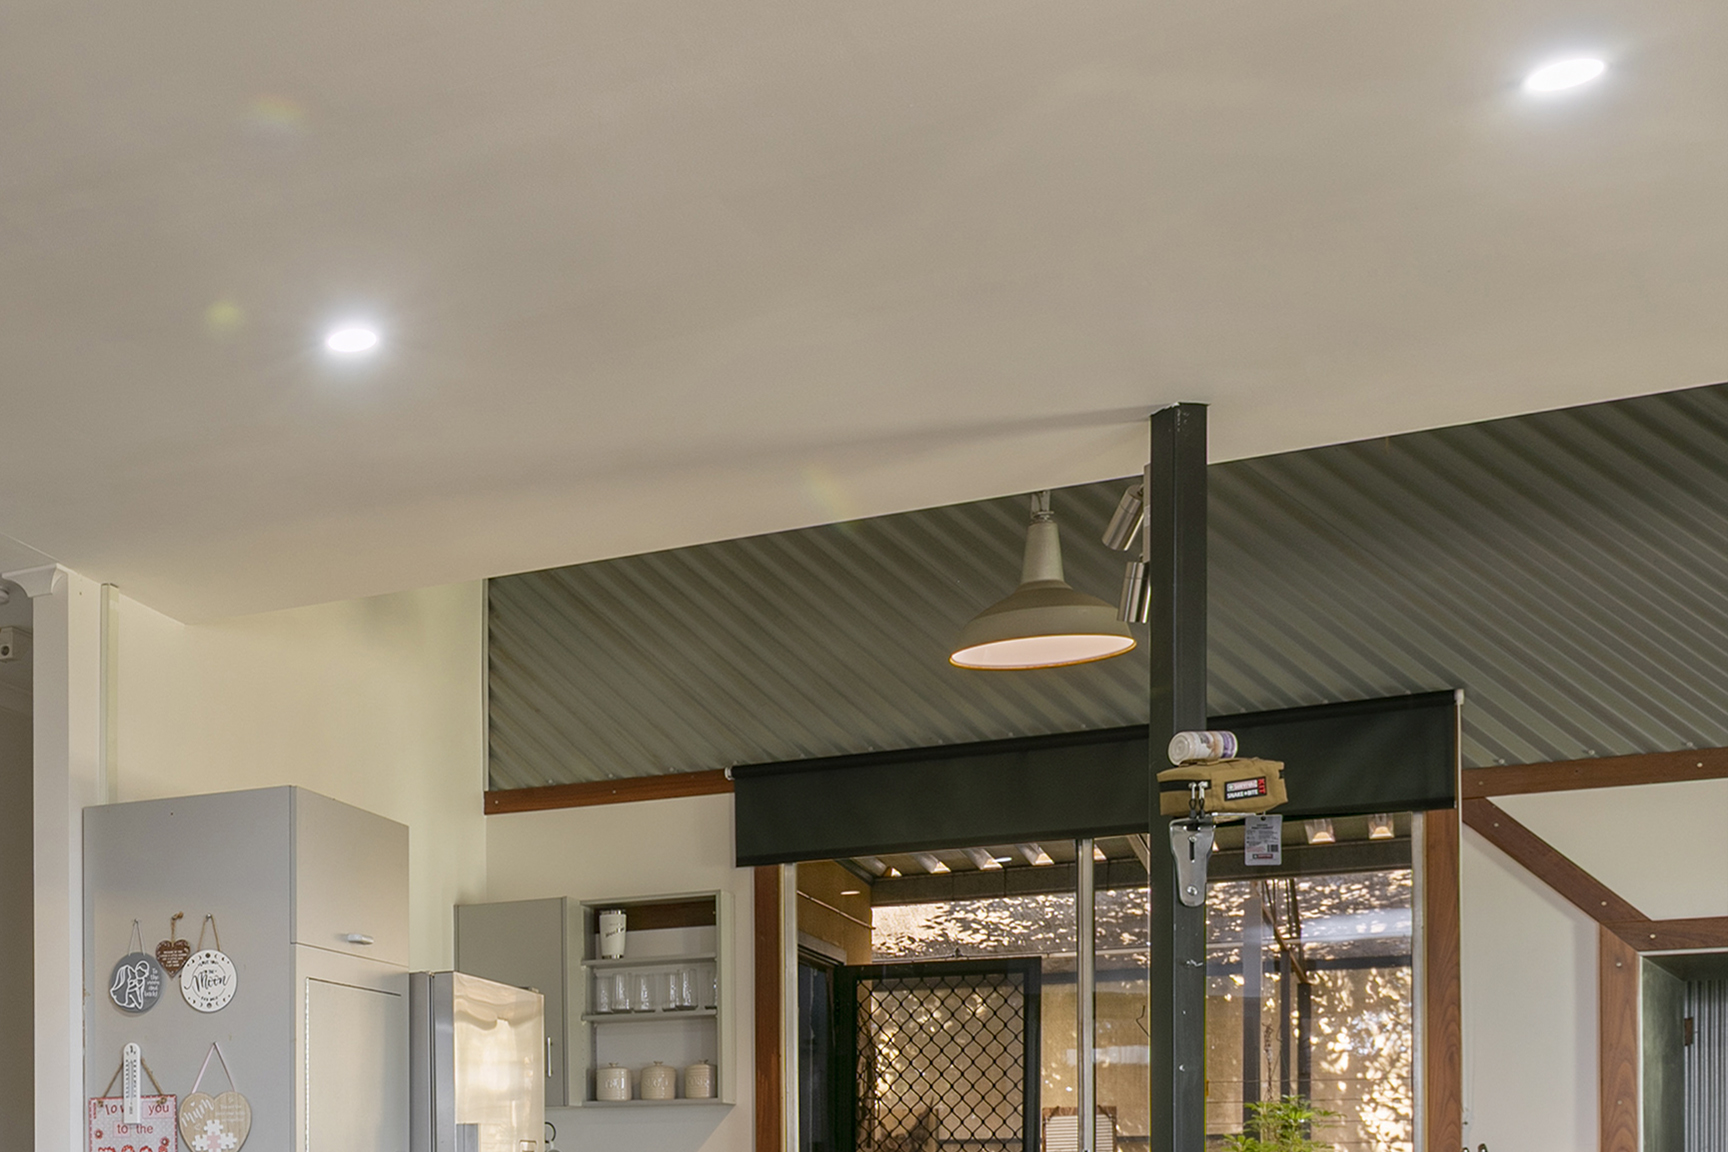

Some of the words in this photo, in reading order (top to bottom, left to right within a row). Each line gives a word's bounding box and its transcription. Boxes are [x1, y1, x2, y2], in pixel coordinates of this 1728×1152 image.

[1227, 791, 1243, 799] SNAKE
[183, 972, 232, 992] Moon
[148, 1104, 170, 1116] you
[117, 1123, 129, 1134] to
[135, 1123, 154, 1134] the
